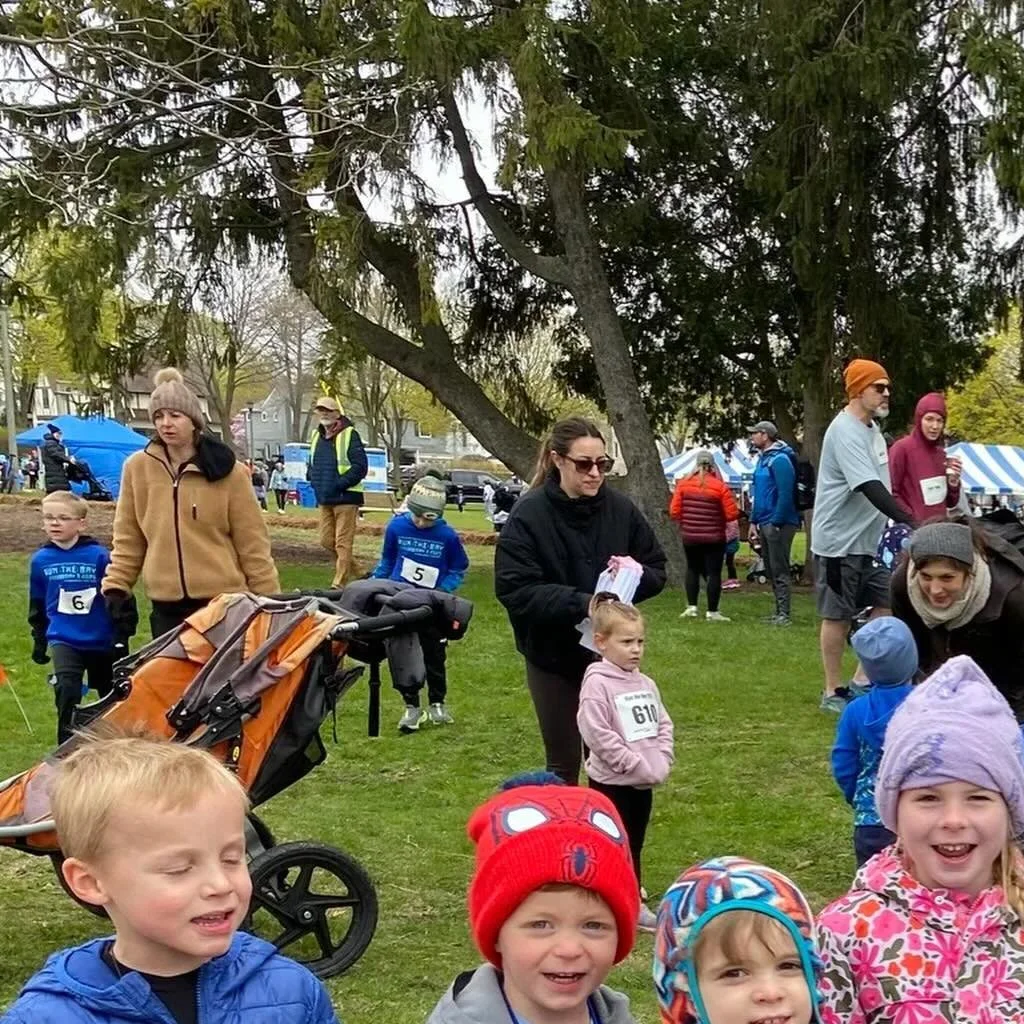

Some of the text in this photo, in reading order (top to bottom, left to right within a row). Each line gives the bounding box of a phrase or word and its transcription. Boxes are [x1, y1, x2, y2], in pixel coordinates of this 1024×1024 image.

[413, 567, 425, 581] 5
[72, 595, 85, 611] 6
[631, 703, 658, 725] 610
